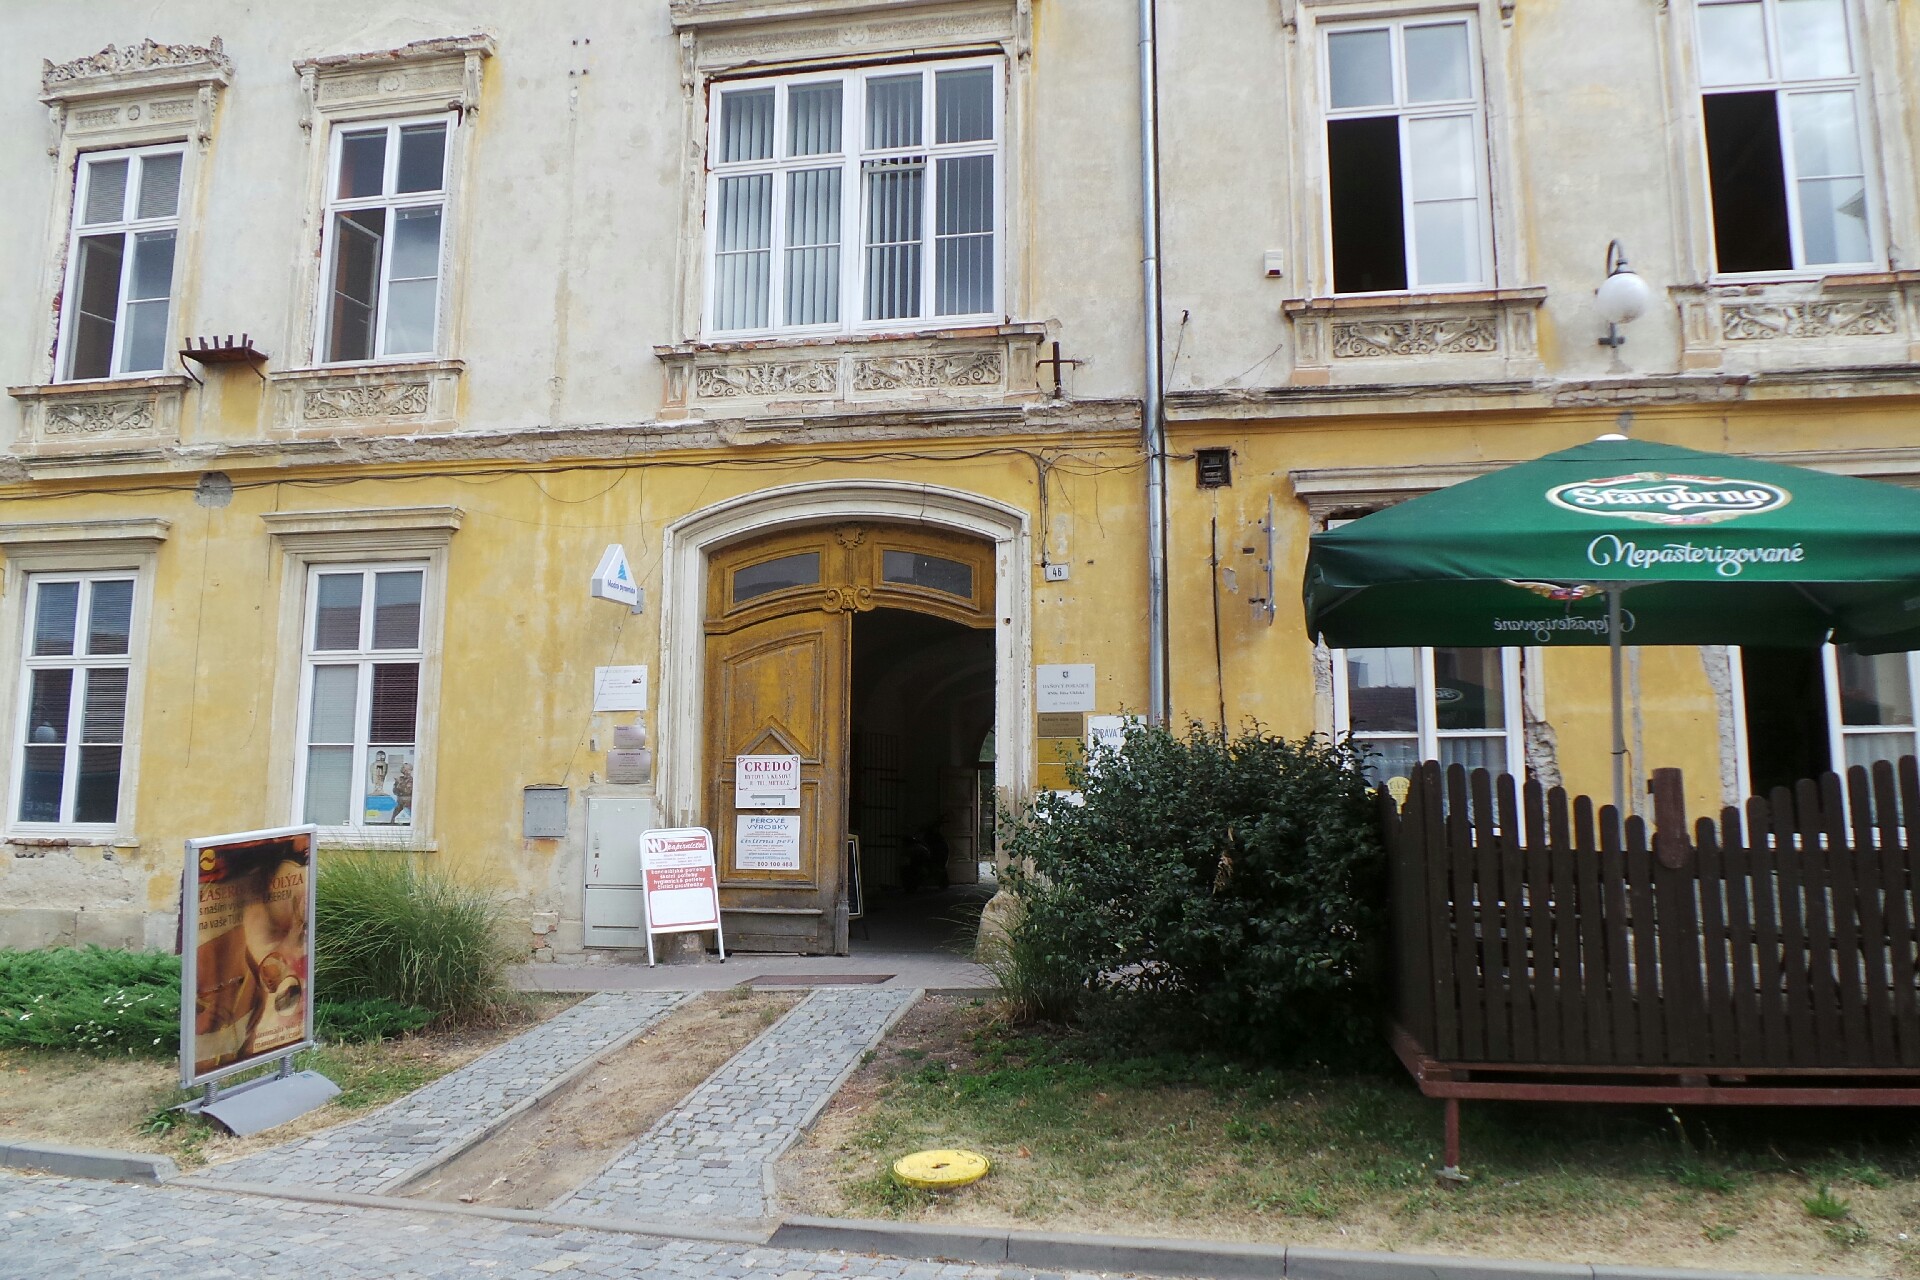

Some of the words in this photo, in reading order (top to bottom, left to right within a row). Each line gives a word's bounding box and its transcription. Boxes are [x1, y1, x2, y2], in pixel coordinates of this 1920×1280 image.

[1572, 486, 1772, 510] Starobrno
[1588, 534, 1805, 577] Nepasterizované
[1052, 567, 1062, 577] 46
[744, 760, 792, 772] CREDO
